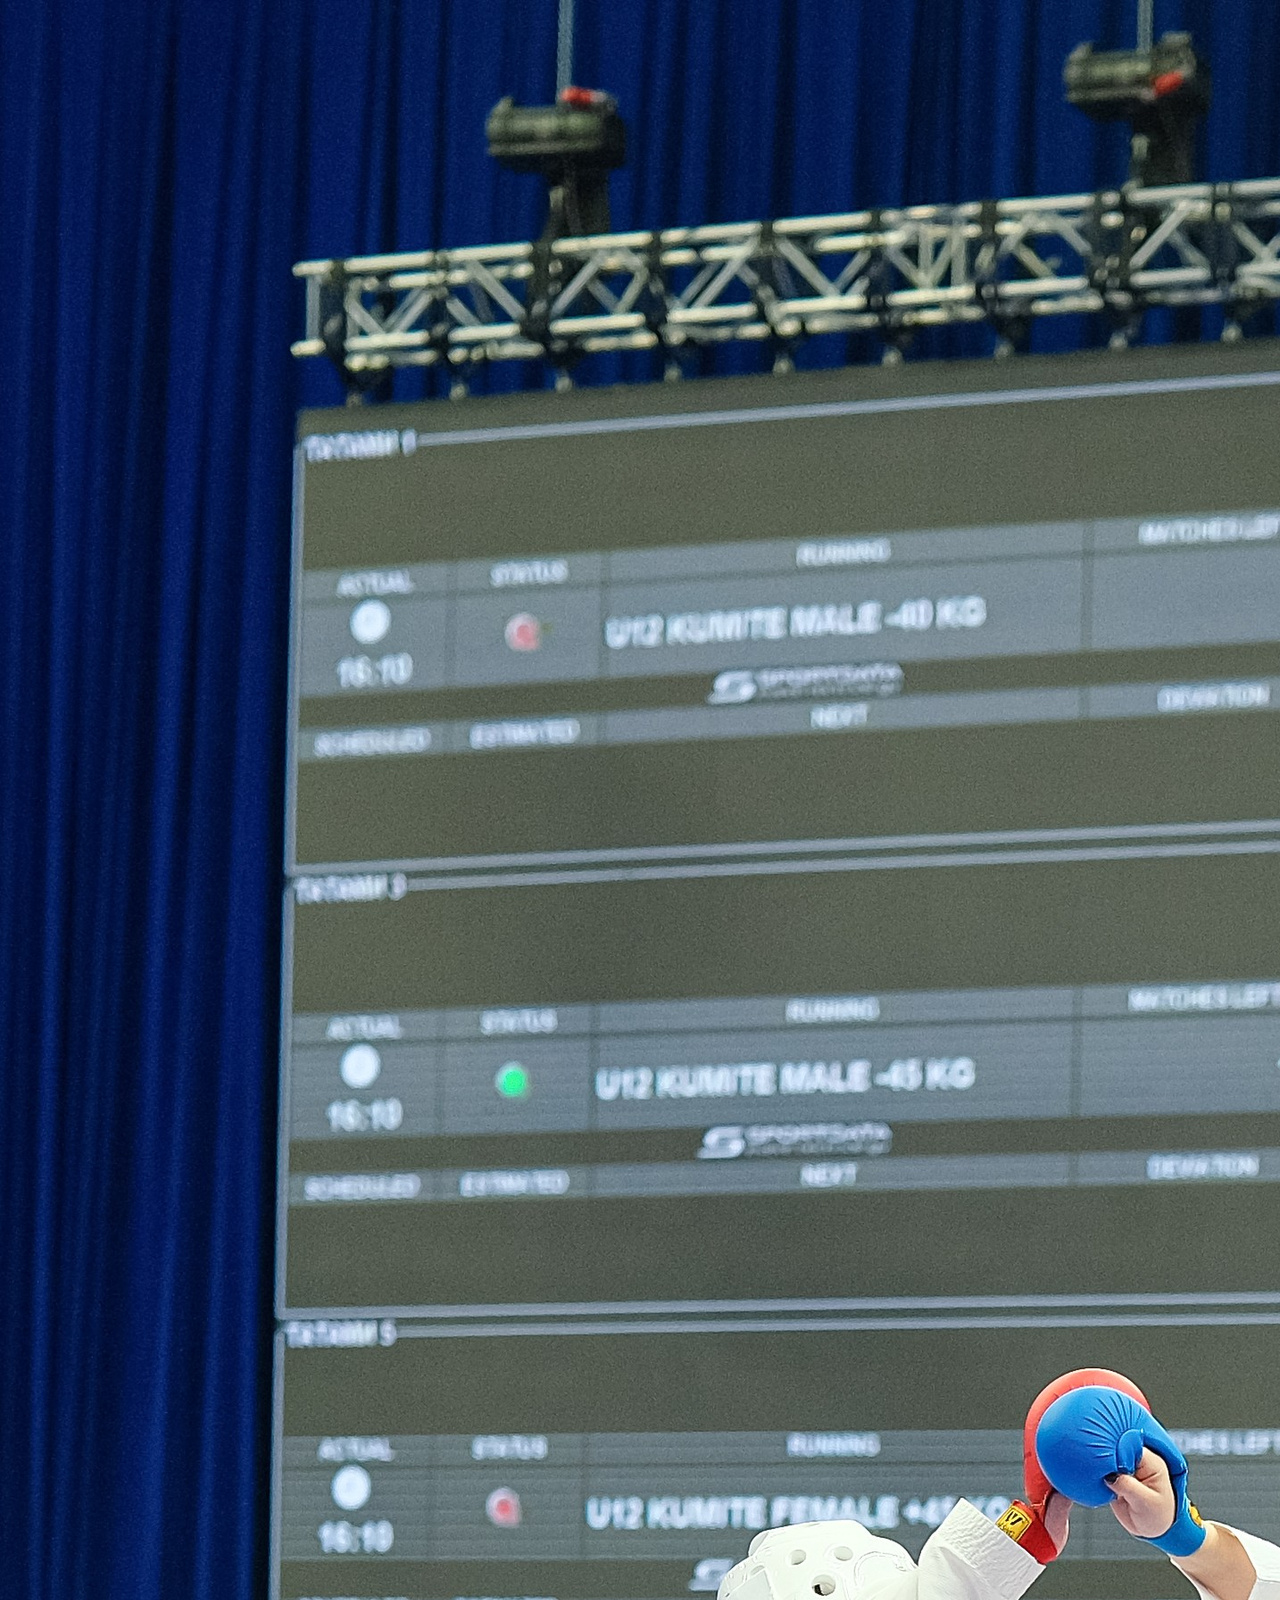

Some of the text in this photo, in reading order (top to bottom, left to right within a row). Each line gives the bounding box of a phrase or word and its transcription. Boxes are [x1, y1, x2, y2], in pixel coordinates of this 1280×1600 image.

[790, 601, 881, 637] MALE
[596, 1067, 652, 1099] U12
[656, 1062, 776, 1097] KUMITE
[780, 1059, 871, 1093] MALE
[586, 1497, 643, 1529] U12
[648, 1496, 768, 1529] KUMITE
